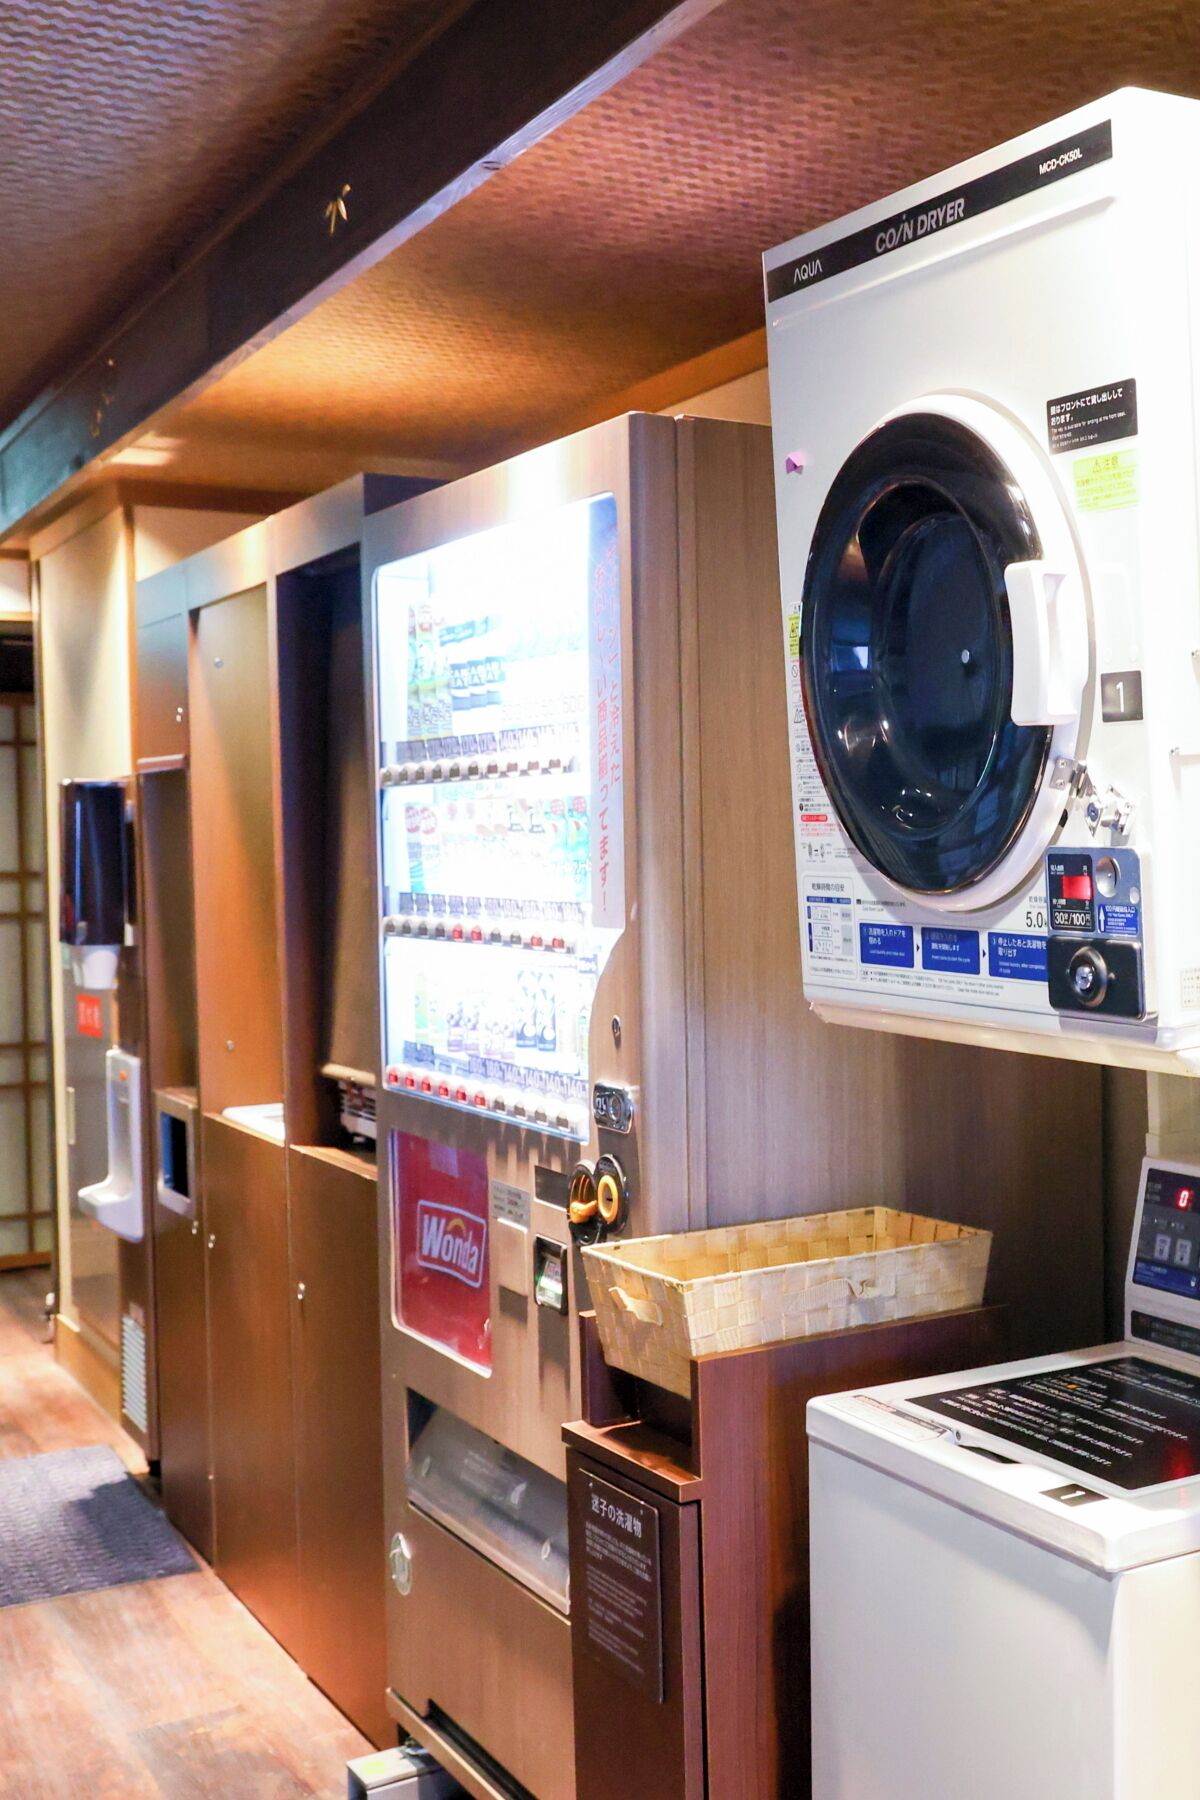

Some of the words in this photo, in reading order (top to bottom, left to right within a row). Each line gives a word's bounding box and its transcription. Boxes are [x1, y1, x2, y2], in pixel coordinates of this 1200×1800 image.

[1039, 148, 1083, 175] MCD-CK50L
[794, 259, 822, 284] AQUA
[917, 199, 964, 236] DRYER
[1116, 681, 1125, 713] 1
[1178, 1190, 1189, 1207] 0
[422, 1215, 479, 1275] Wonda
[591, 1493, 643, 1539] 迷子の洗濯物
